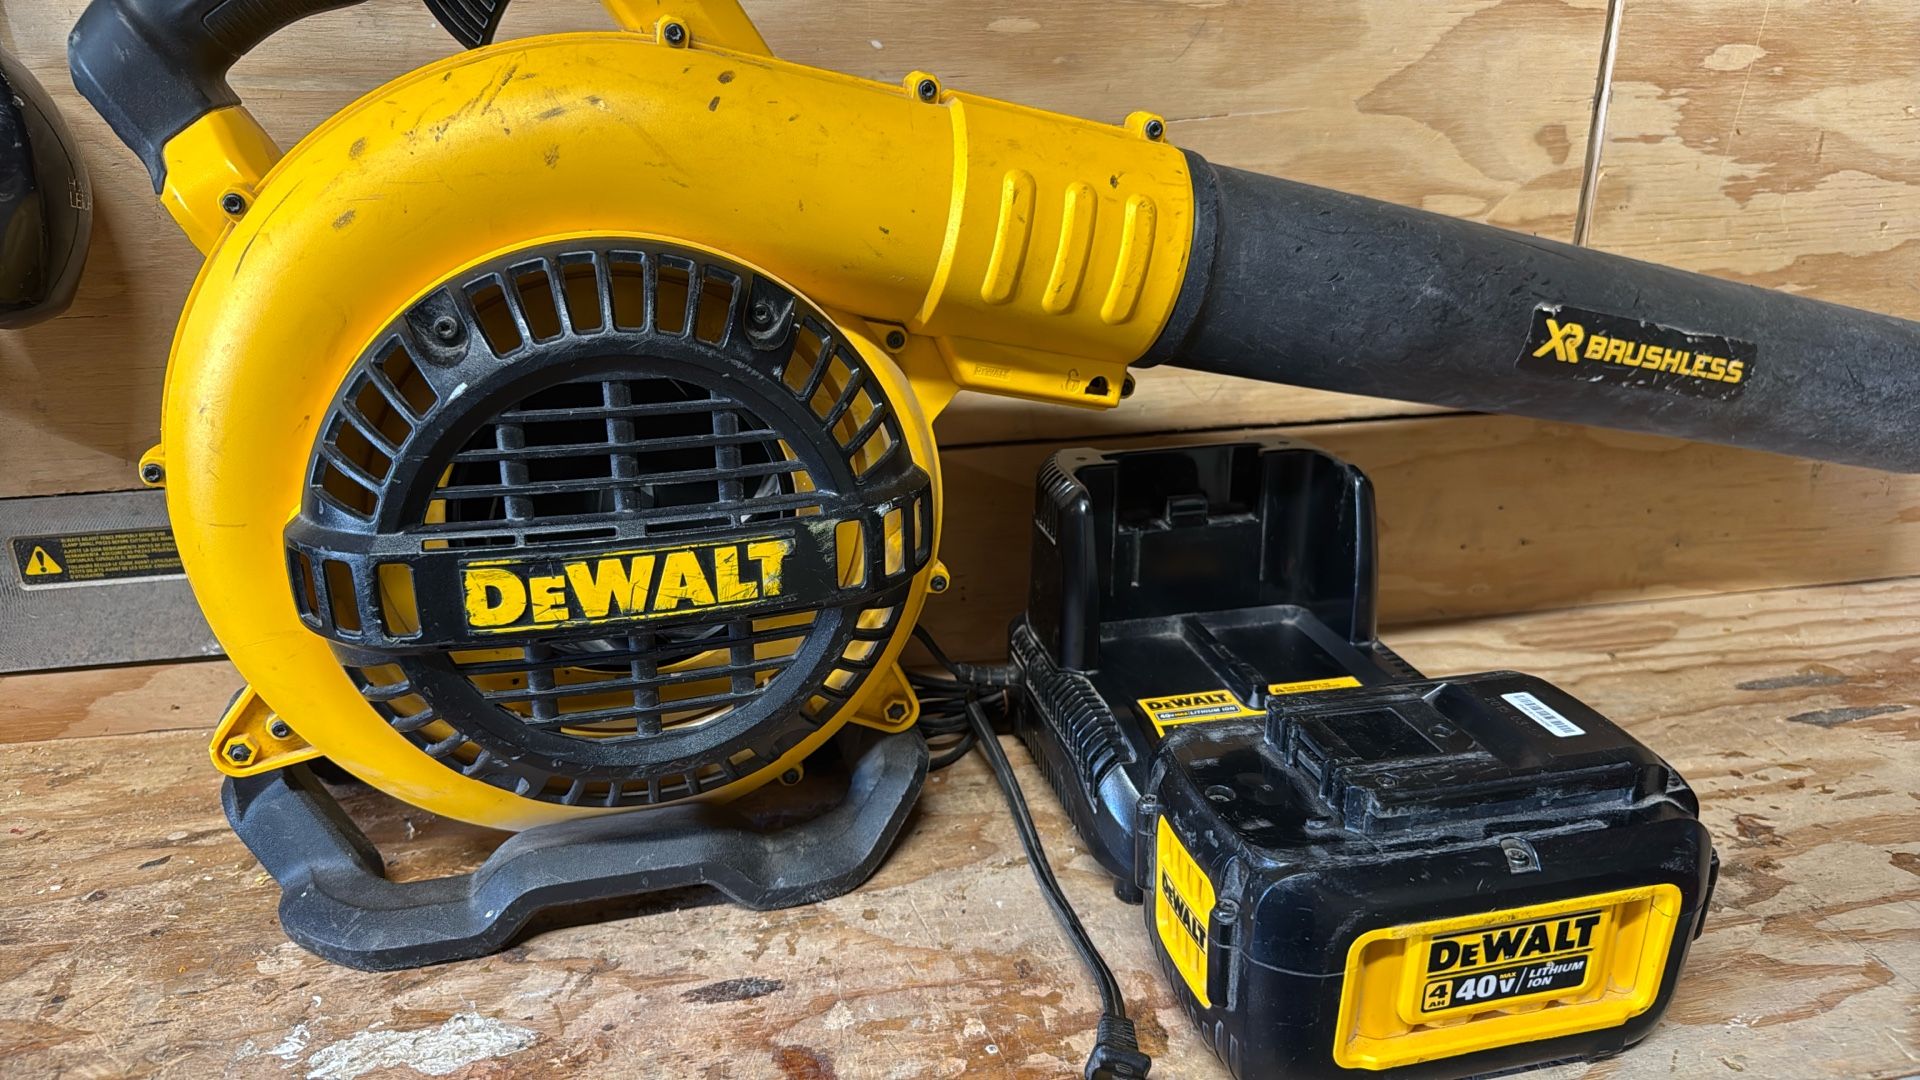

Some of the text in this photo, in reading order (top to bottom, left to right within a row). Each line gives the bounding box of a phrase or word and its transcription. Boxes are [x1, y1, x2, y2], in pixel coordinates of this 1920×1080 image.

[1532, 318, 1745, 384] XR BRUSHLESS
[465, 541, 785, 626] DEWALT
[1427, 915, 1601, 973] DEWALT
[1499, 971, 1517, 980] MAX
[1528, 960, 1584, 978] LITHIUM
[1527, 976, 1553, 988] ION
[1429, 983, 1449, 999] 4
[1428, 1000, 1446, 1008] AH
